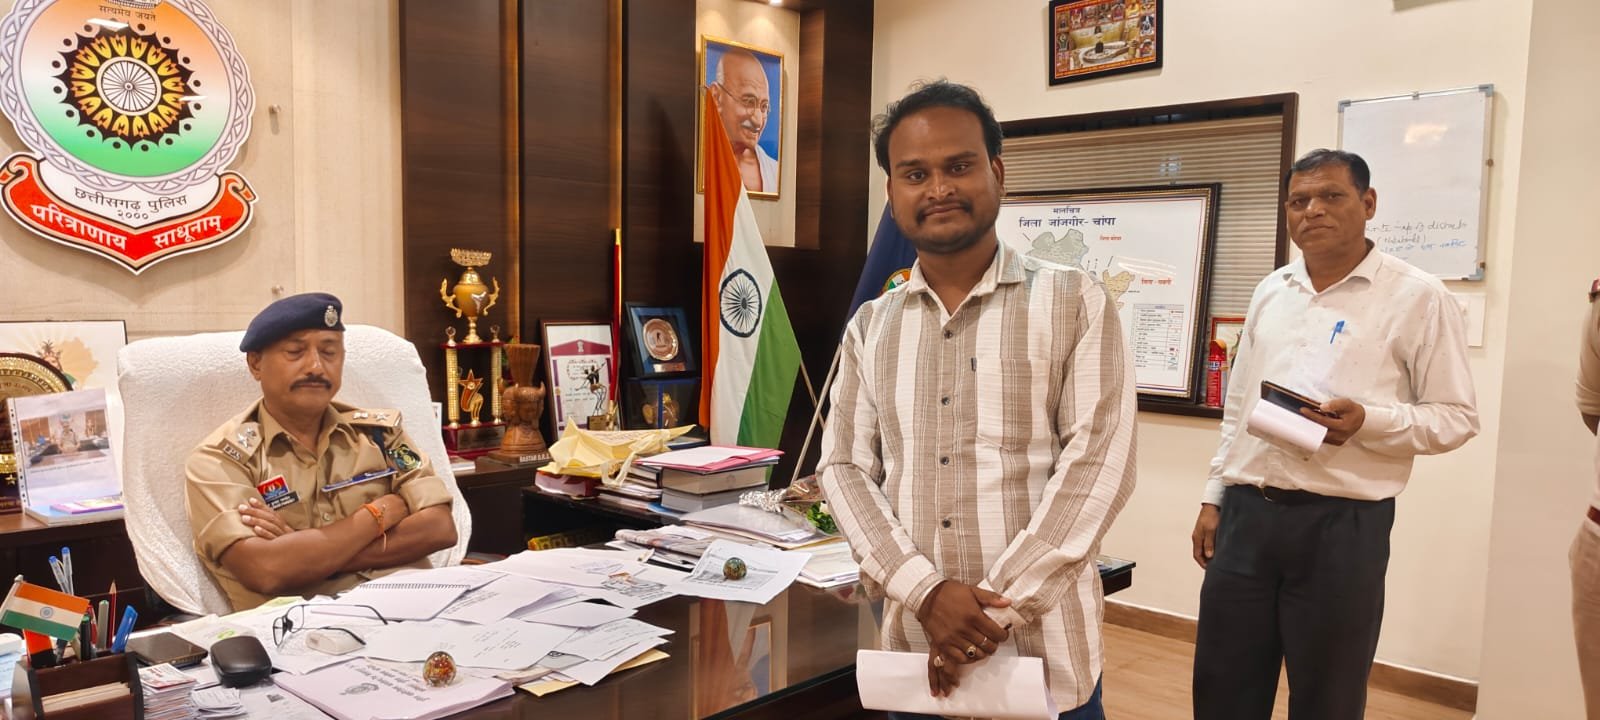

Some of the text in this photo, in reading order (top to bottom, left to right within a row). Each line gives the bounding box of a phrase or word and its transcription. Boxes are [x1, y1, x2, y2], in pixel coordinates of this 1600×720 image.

[148, 194, 187, 213] पुलिस
[30, 203, 223, 250] परित्राणाय साधूनाम्
[1019, 216, 1042, 228] जिला
